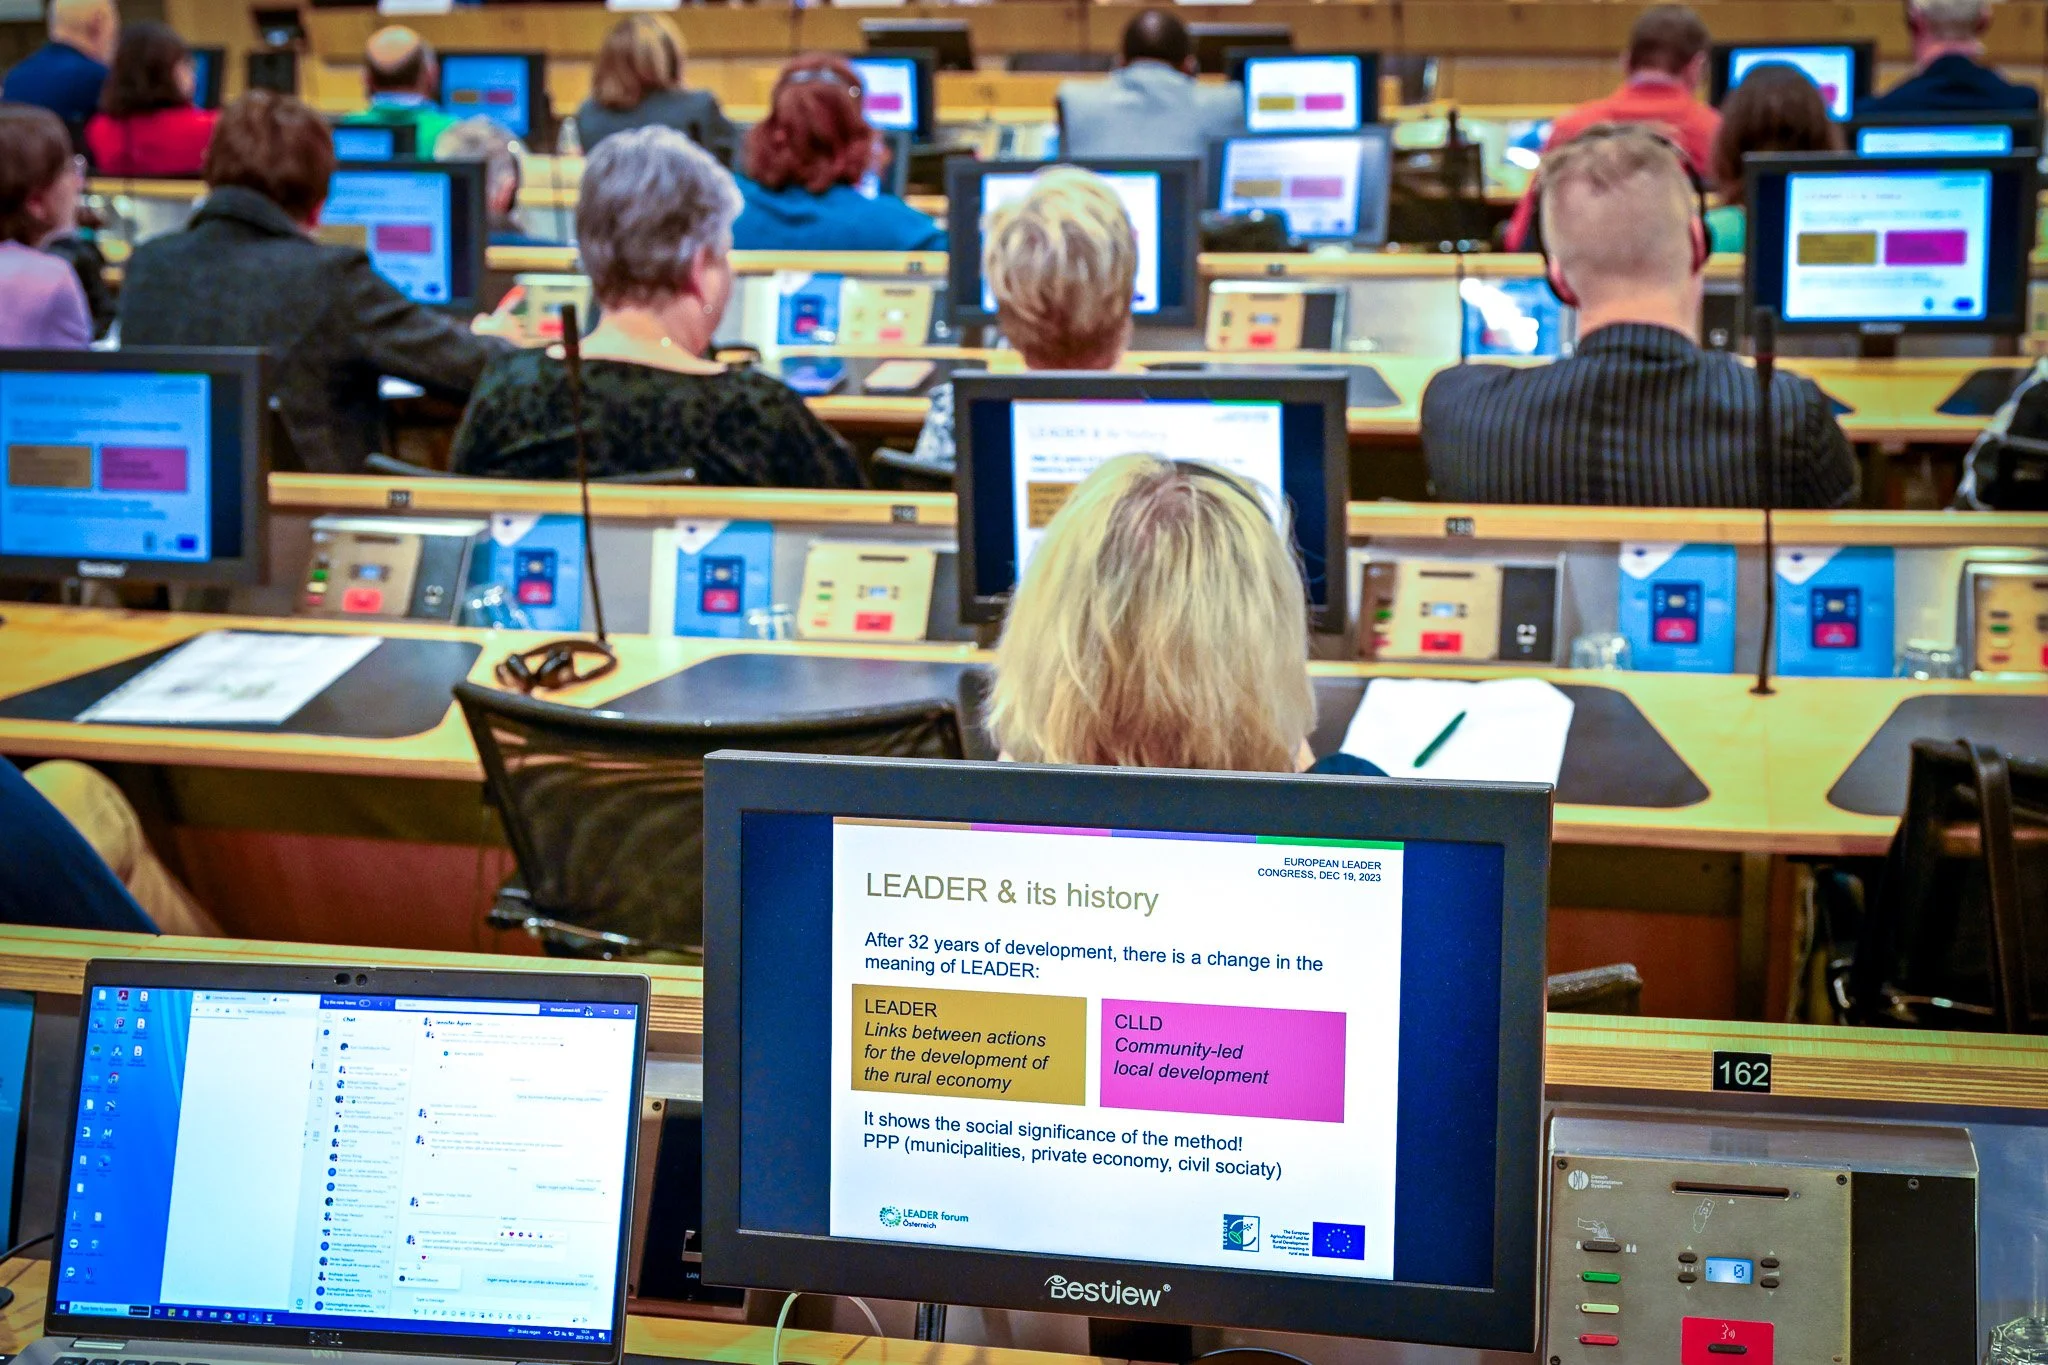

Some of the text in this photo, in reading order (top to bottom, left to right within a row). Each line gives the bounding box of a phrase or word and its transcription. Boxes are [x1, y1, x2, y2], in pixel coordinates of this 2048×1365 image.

[1258, 868, 1381, 882] CONGRESS, DEC 19, 2023
[1284, 857, 1381, 870] EUROPEAN LEADER
[867, 872, 1159, 917] LEADER & its history
[865, 932, 1323, 972] After 32 years of development, there is a change in the
[865, 956, 1039, 978] meaning of LEADER:
[865, 999, 938, 1018] LEADER
[864, 1021, 1046, 1047] Links between actions
[1115, 1014, 1163, 1031] CLLD
[864, 1043, 1050, 1070] for the development of
[1115, 1037, 1244, 1061] Community-led
[864, 1066, 1012, 1094] the rural economy
[1113, 1060, 1270, 1085] local development
[1719, 1060, 1770, 1087] 162
[864, 1111, 1242, 1151] It shows the social significance of the method!
[864, 1133, 1282, 1181] PPP (municipalities, private economy, civil sociaty)
[902, 1219, 937, 1229] Österreich
[903, 1208, 969, 1222] LEADER forum
